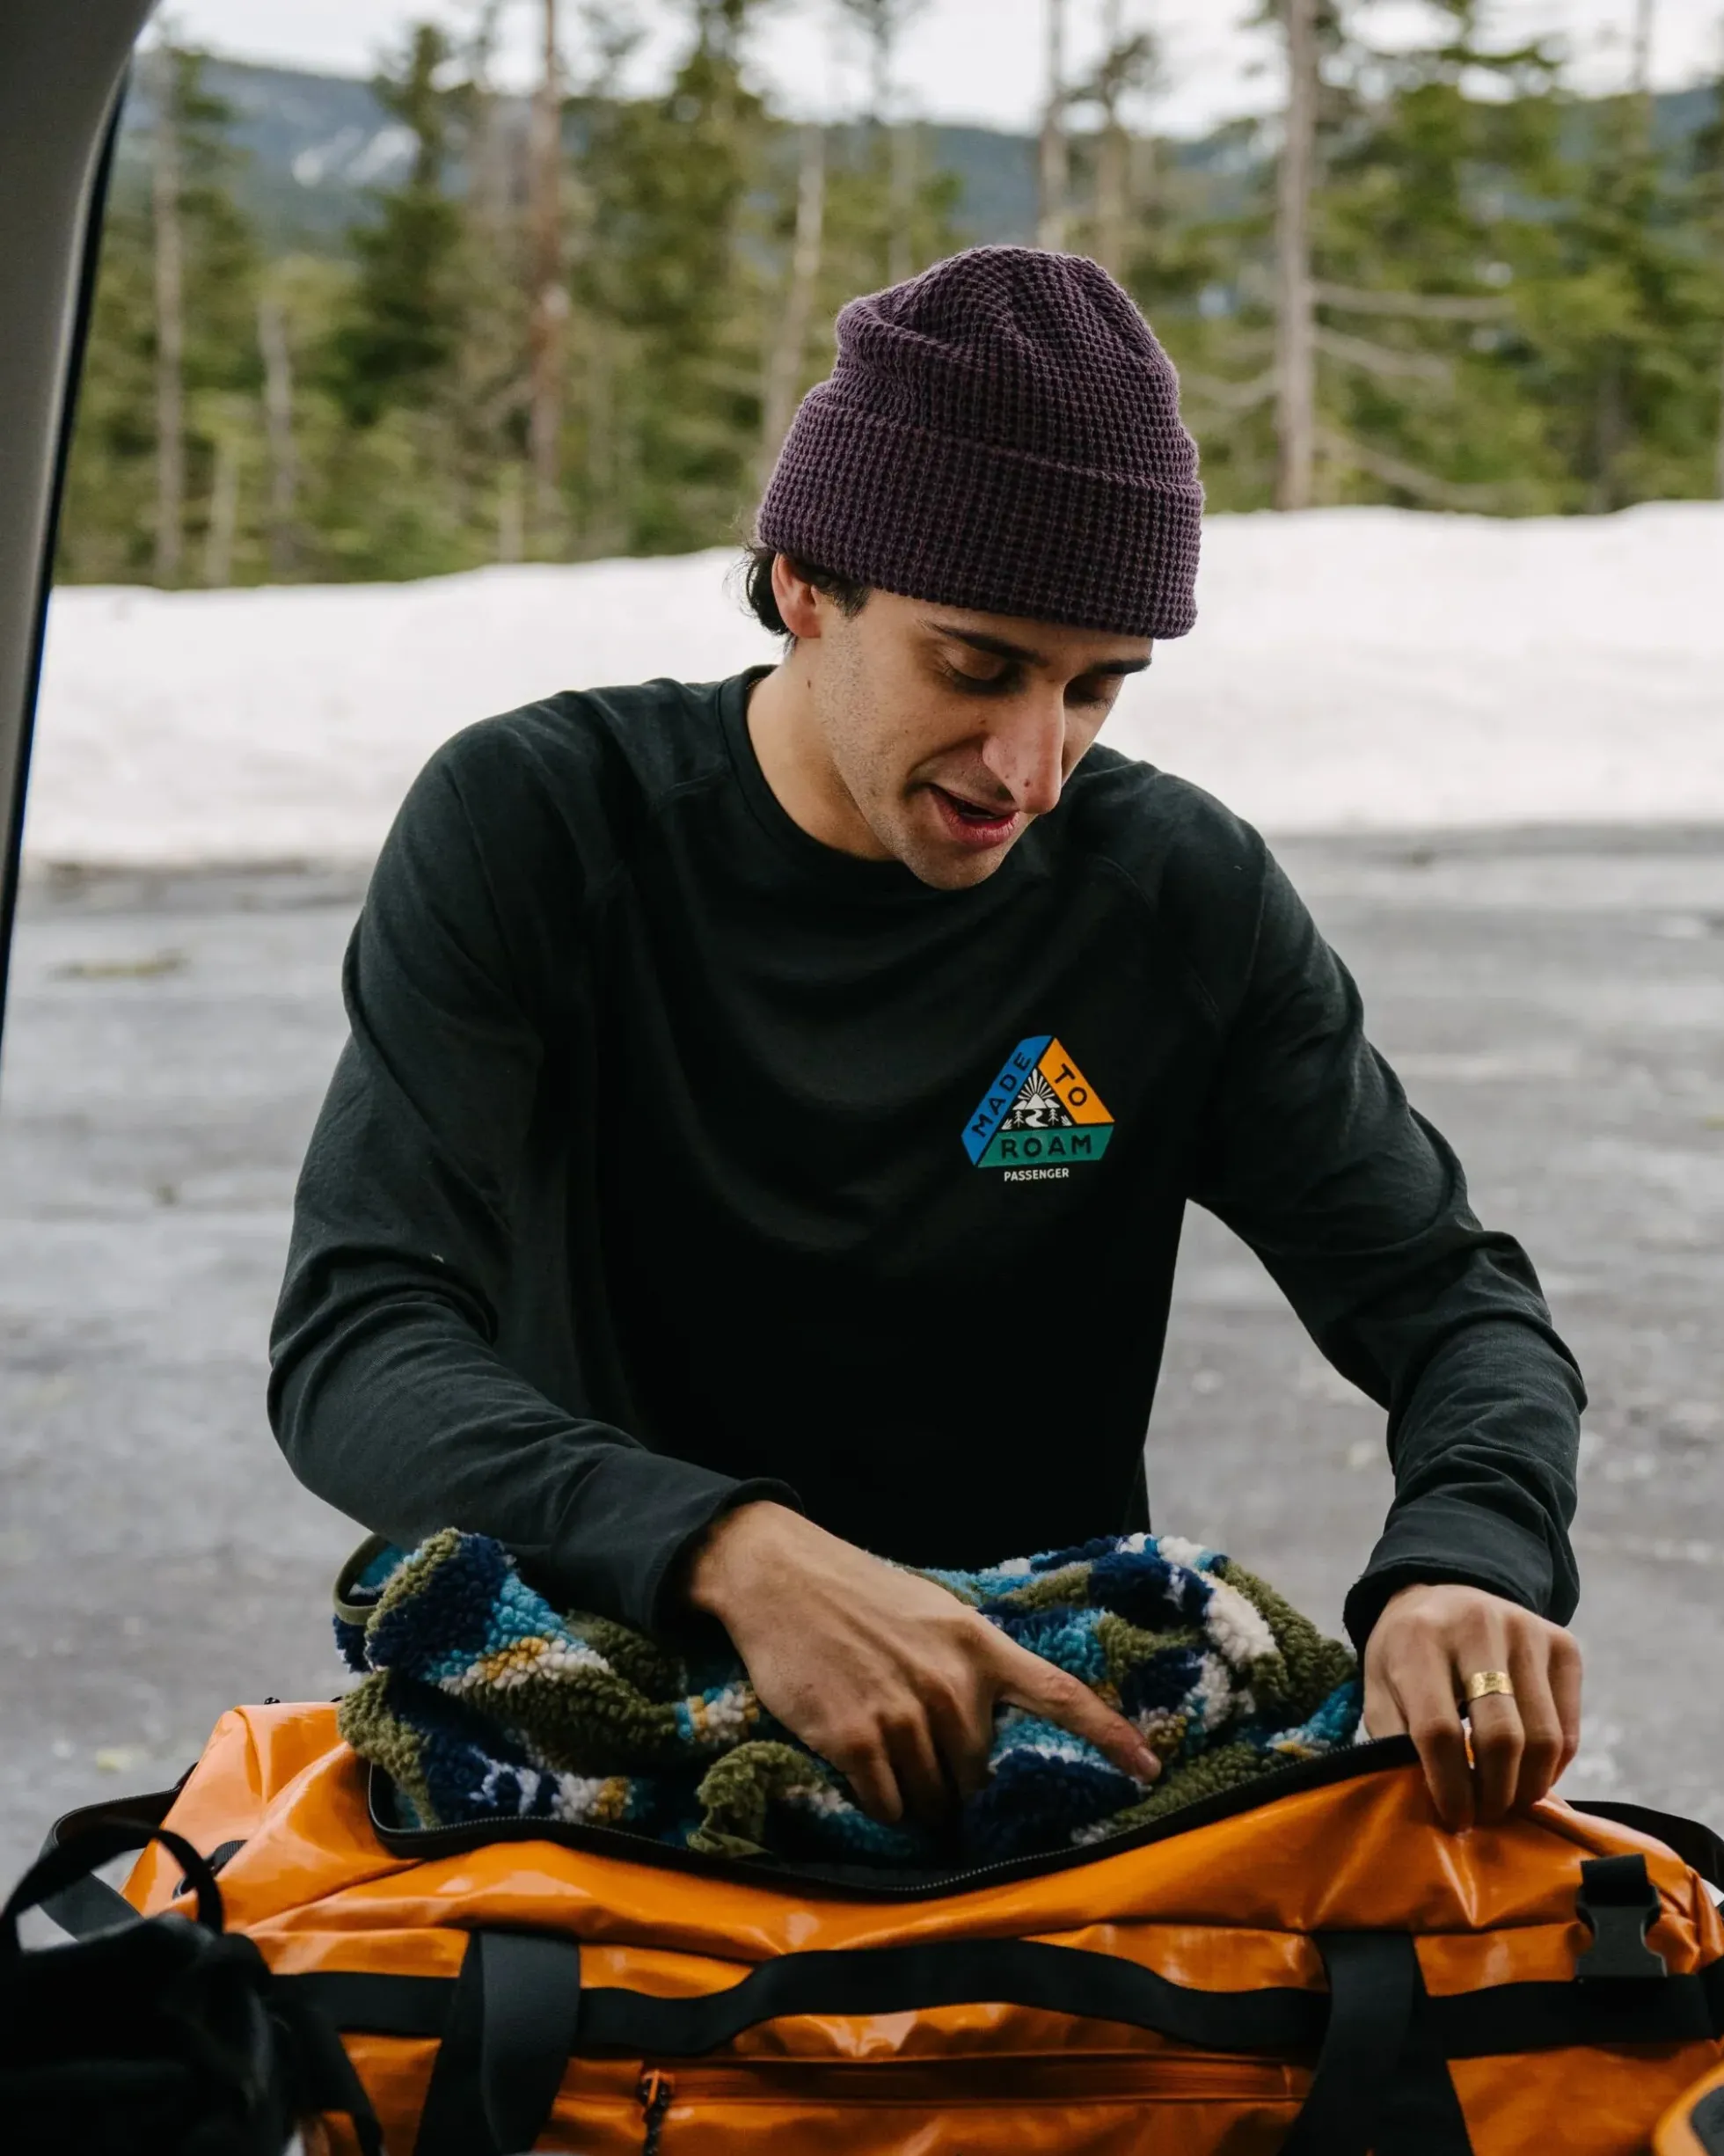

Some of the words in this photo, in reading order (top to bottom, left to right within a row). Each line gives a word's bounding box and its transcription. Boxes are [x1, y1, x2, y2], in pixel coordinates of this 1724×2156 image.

[971, 1052, 1032, 1138] MADE
[1055, 1063, 1087, 1107] TO
[1001, 1135, 1092, 1158] ROAM
[1004, 1168, 1070, 1181] PASSENGER
